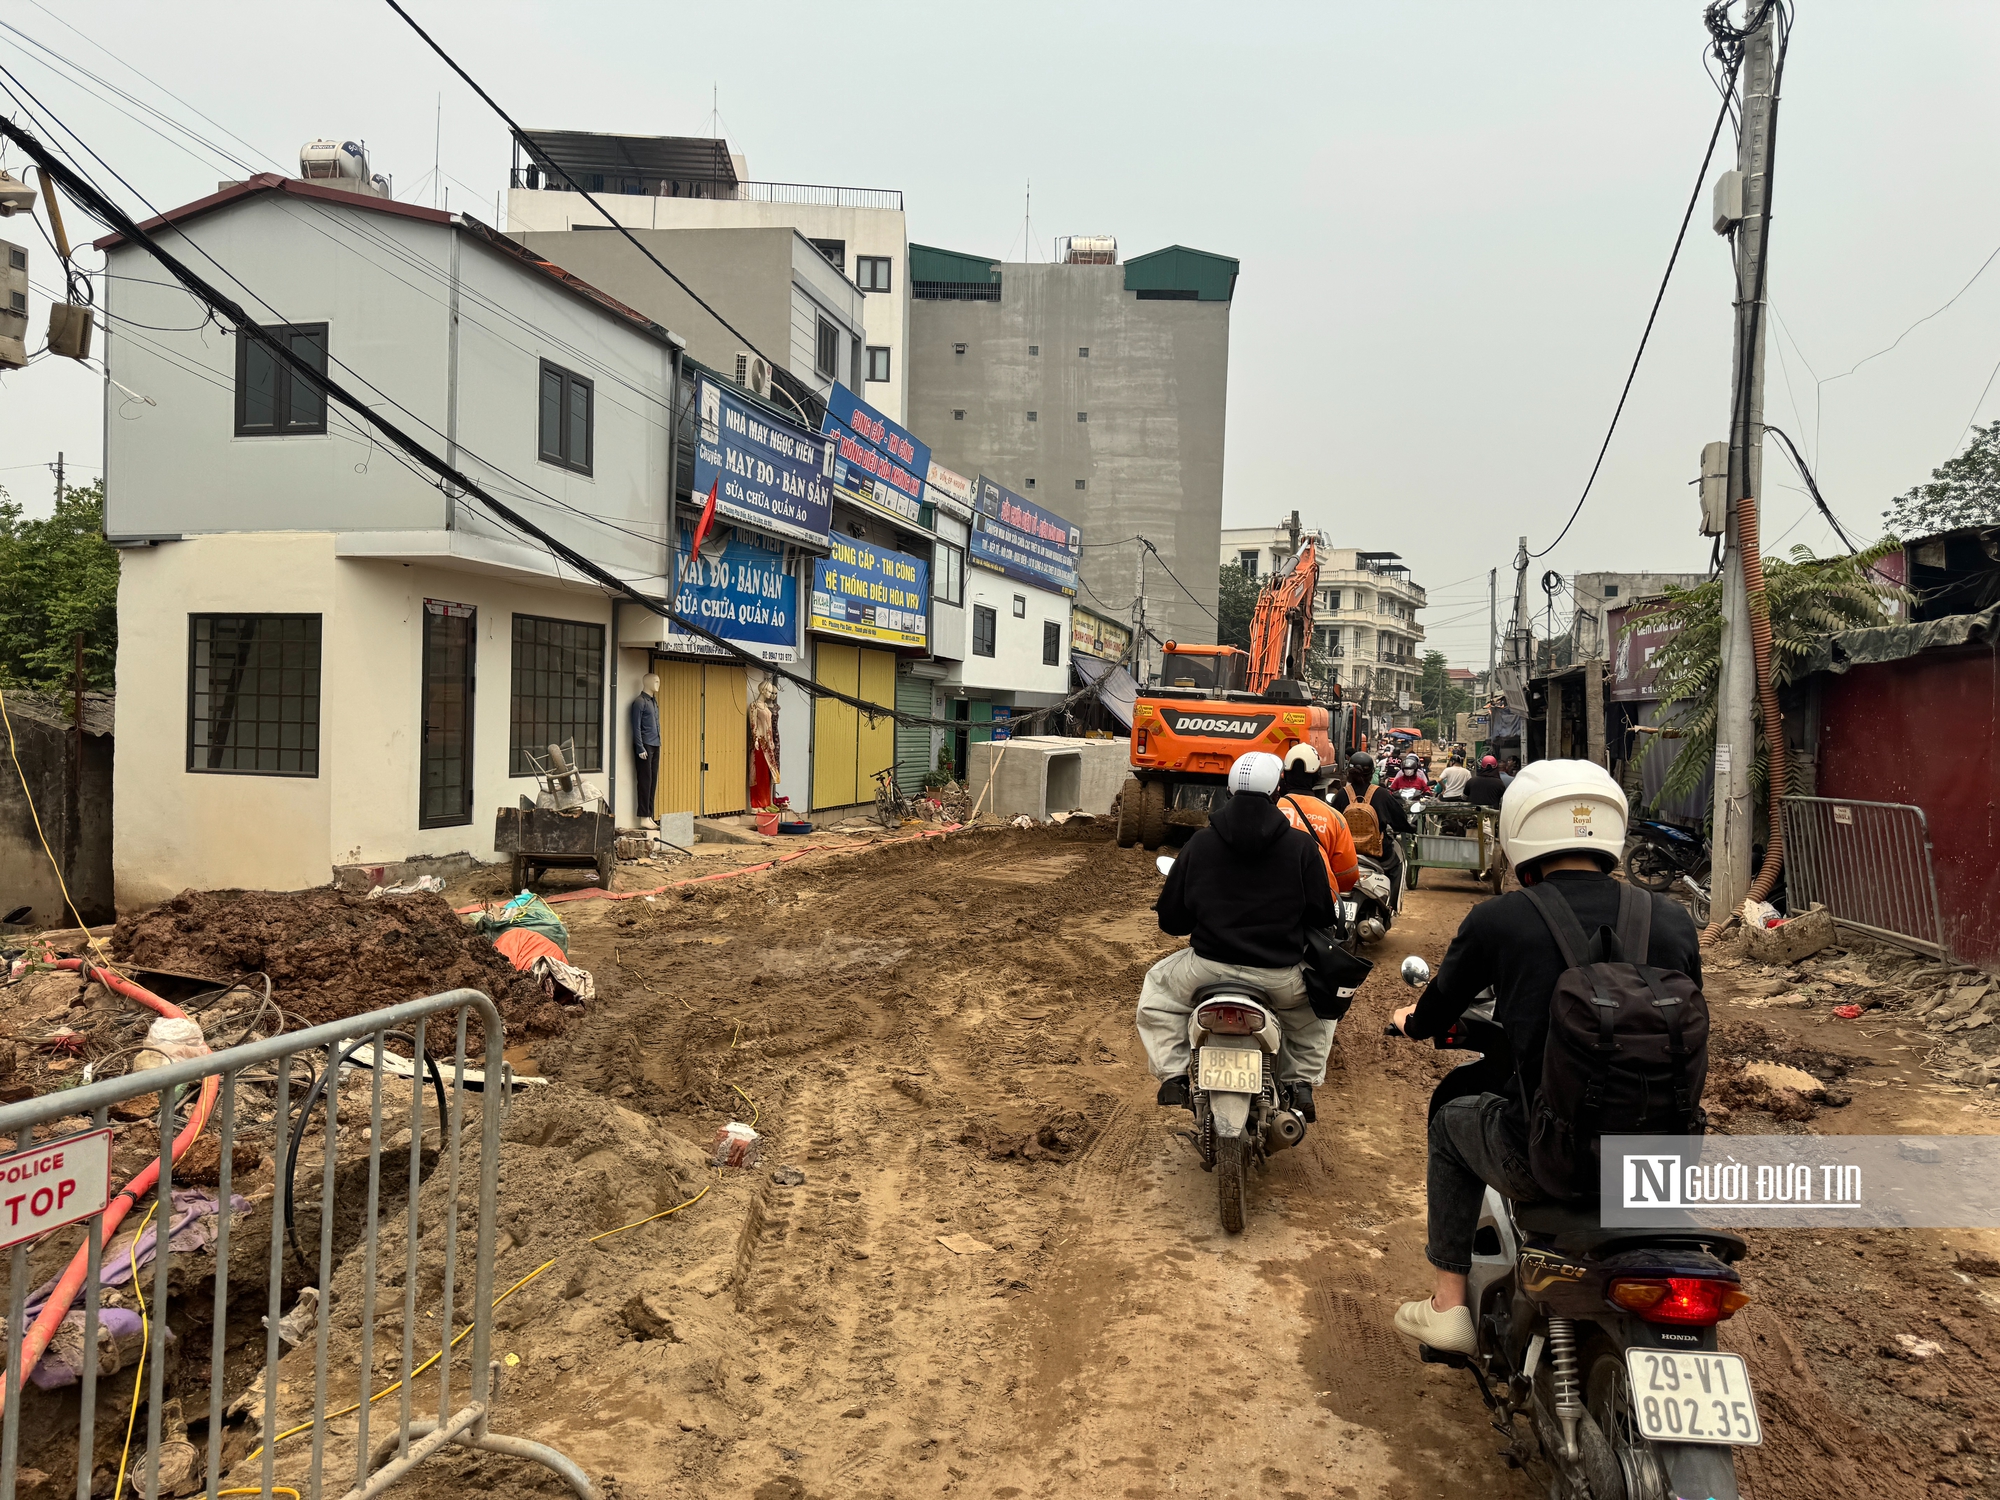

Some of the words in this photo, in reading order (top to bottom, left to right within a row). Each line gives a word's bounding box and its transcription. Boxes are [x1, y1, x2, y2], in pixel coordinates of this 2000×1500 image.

[749, 419, 769, 445] MAY
[770, 430, 795, 457] NGỌC
[851, 409, 871, 438] CUNG
[725, 447, 754, 479] MAY
[757, 460, 774, 486] ĐO
[782, 469, 806, 499] BÁN
[725, 480, 744, 501] SỬA
[746, 491, 770, 510] CHỮA
[796, 505, 807, 522] ÁO
[678, 554, 704, 586] MAY
[737, 561, 761, 595] BÁN
[832, 541, 856, 566] CUNG
[882, 558, 894, 577] THI
[895, 561, 915, 582] CÔNG
[825, 569, 837, 594] HỆ
[840, 573, 868, 598] THỐNG
[890, 586, 904, 607] HÒA
[674, 589, 697, 614] SỬA
[771, 605, 785, 627] ÁO
[1176, 718, 1258, 734] DOOSAN
[1573, 816, 1592, 826] Royal
[1204, 1068, 1257, 1090] 670.68
[5, 1179, 76, 1226] TOP
[1661, 1333, 1698, 1341] HONDA
[1644, 1354, 1729, 1395] 29-V1
[1643, 1395, 1752, 1439] 802.35
